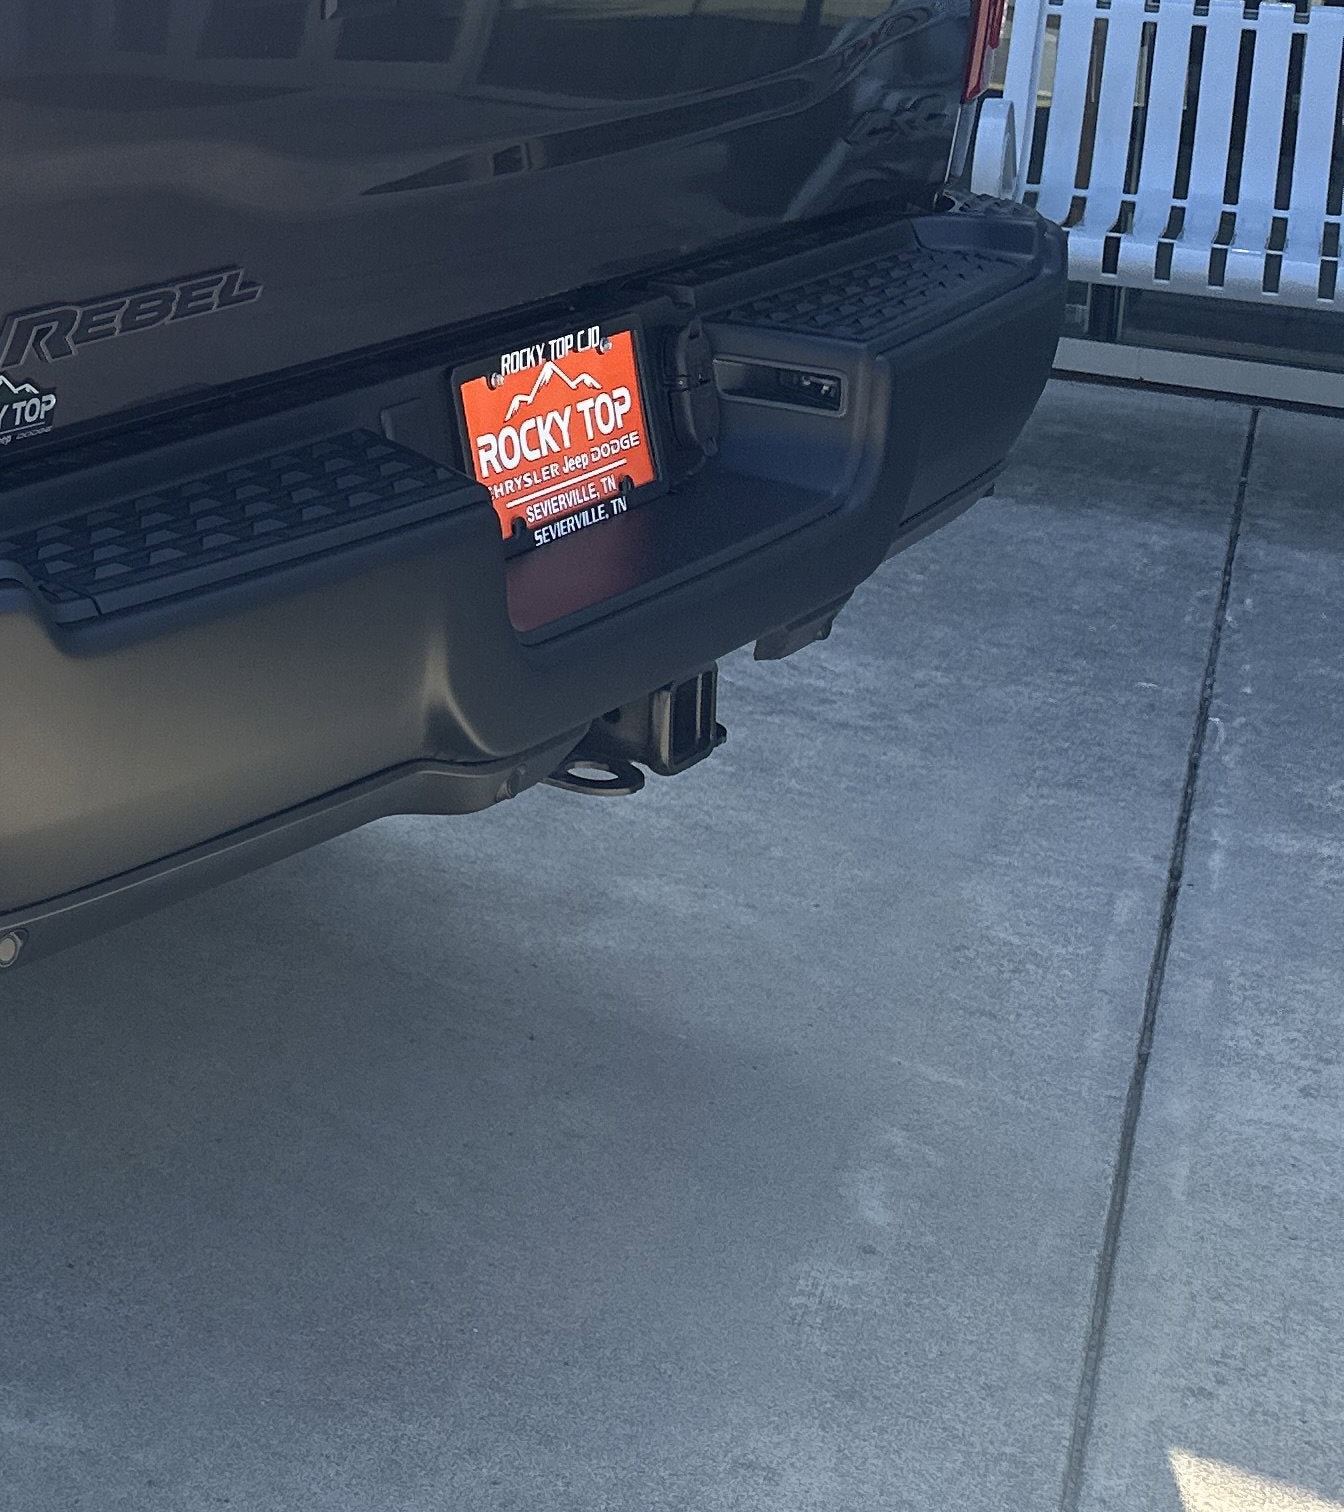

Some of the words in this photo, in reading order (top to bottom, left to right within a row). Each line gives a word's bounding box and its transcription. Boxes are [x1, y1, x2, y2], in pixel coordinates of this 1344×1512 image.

[501, 343, 546, 376] ROCKY
[548, 334, 574, 361] TOP
[577, 326, 600, 352] CJD
[12, 394, 56, 426] TOP
[476, 404, 572, 478] ROCKY
[576, 386, 632, 441] TOP
[562, 452, 589, 474] Jeep
[590, 431, 641, 462] DODGE
[526, 482, 601, 523] SEVIERVILLE,
[600, 475, 617, 495] TN
[534, 503, 610, 547] SEVIERVILLE,
[610, 496, 628, 516] TN
